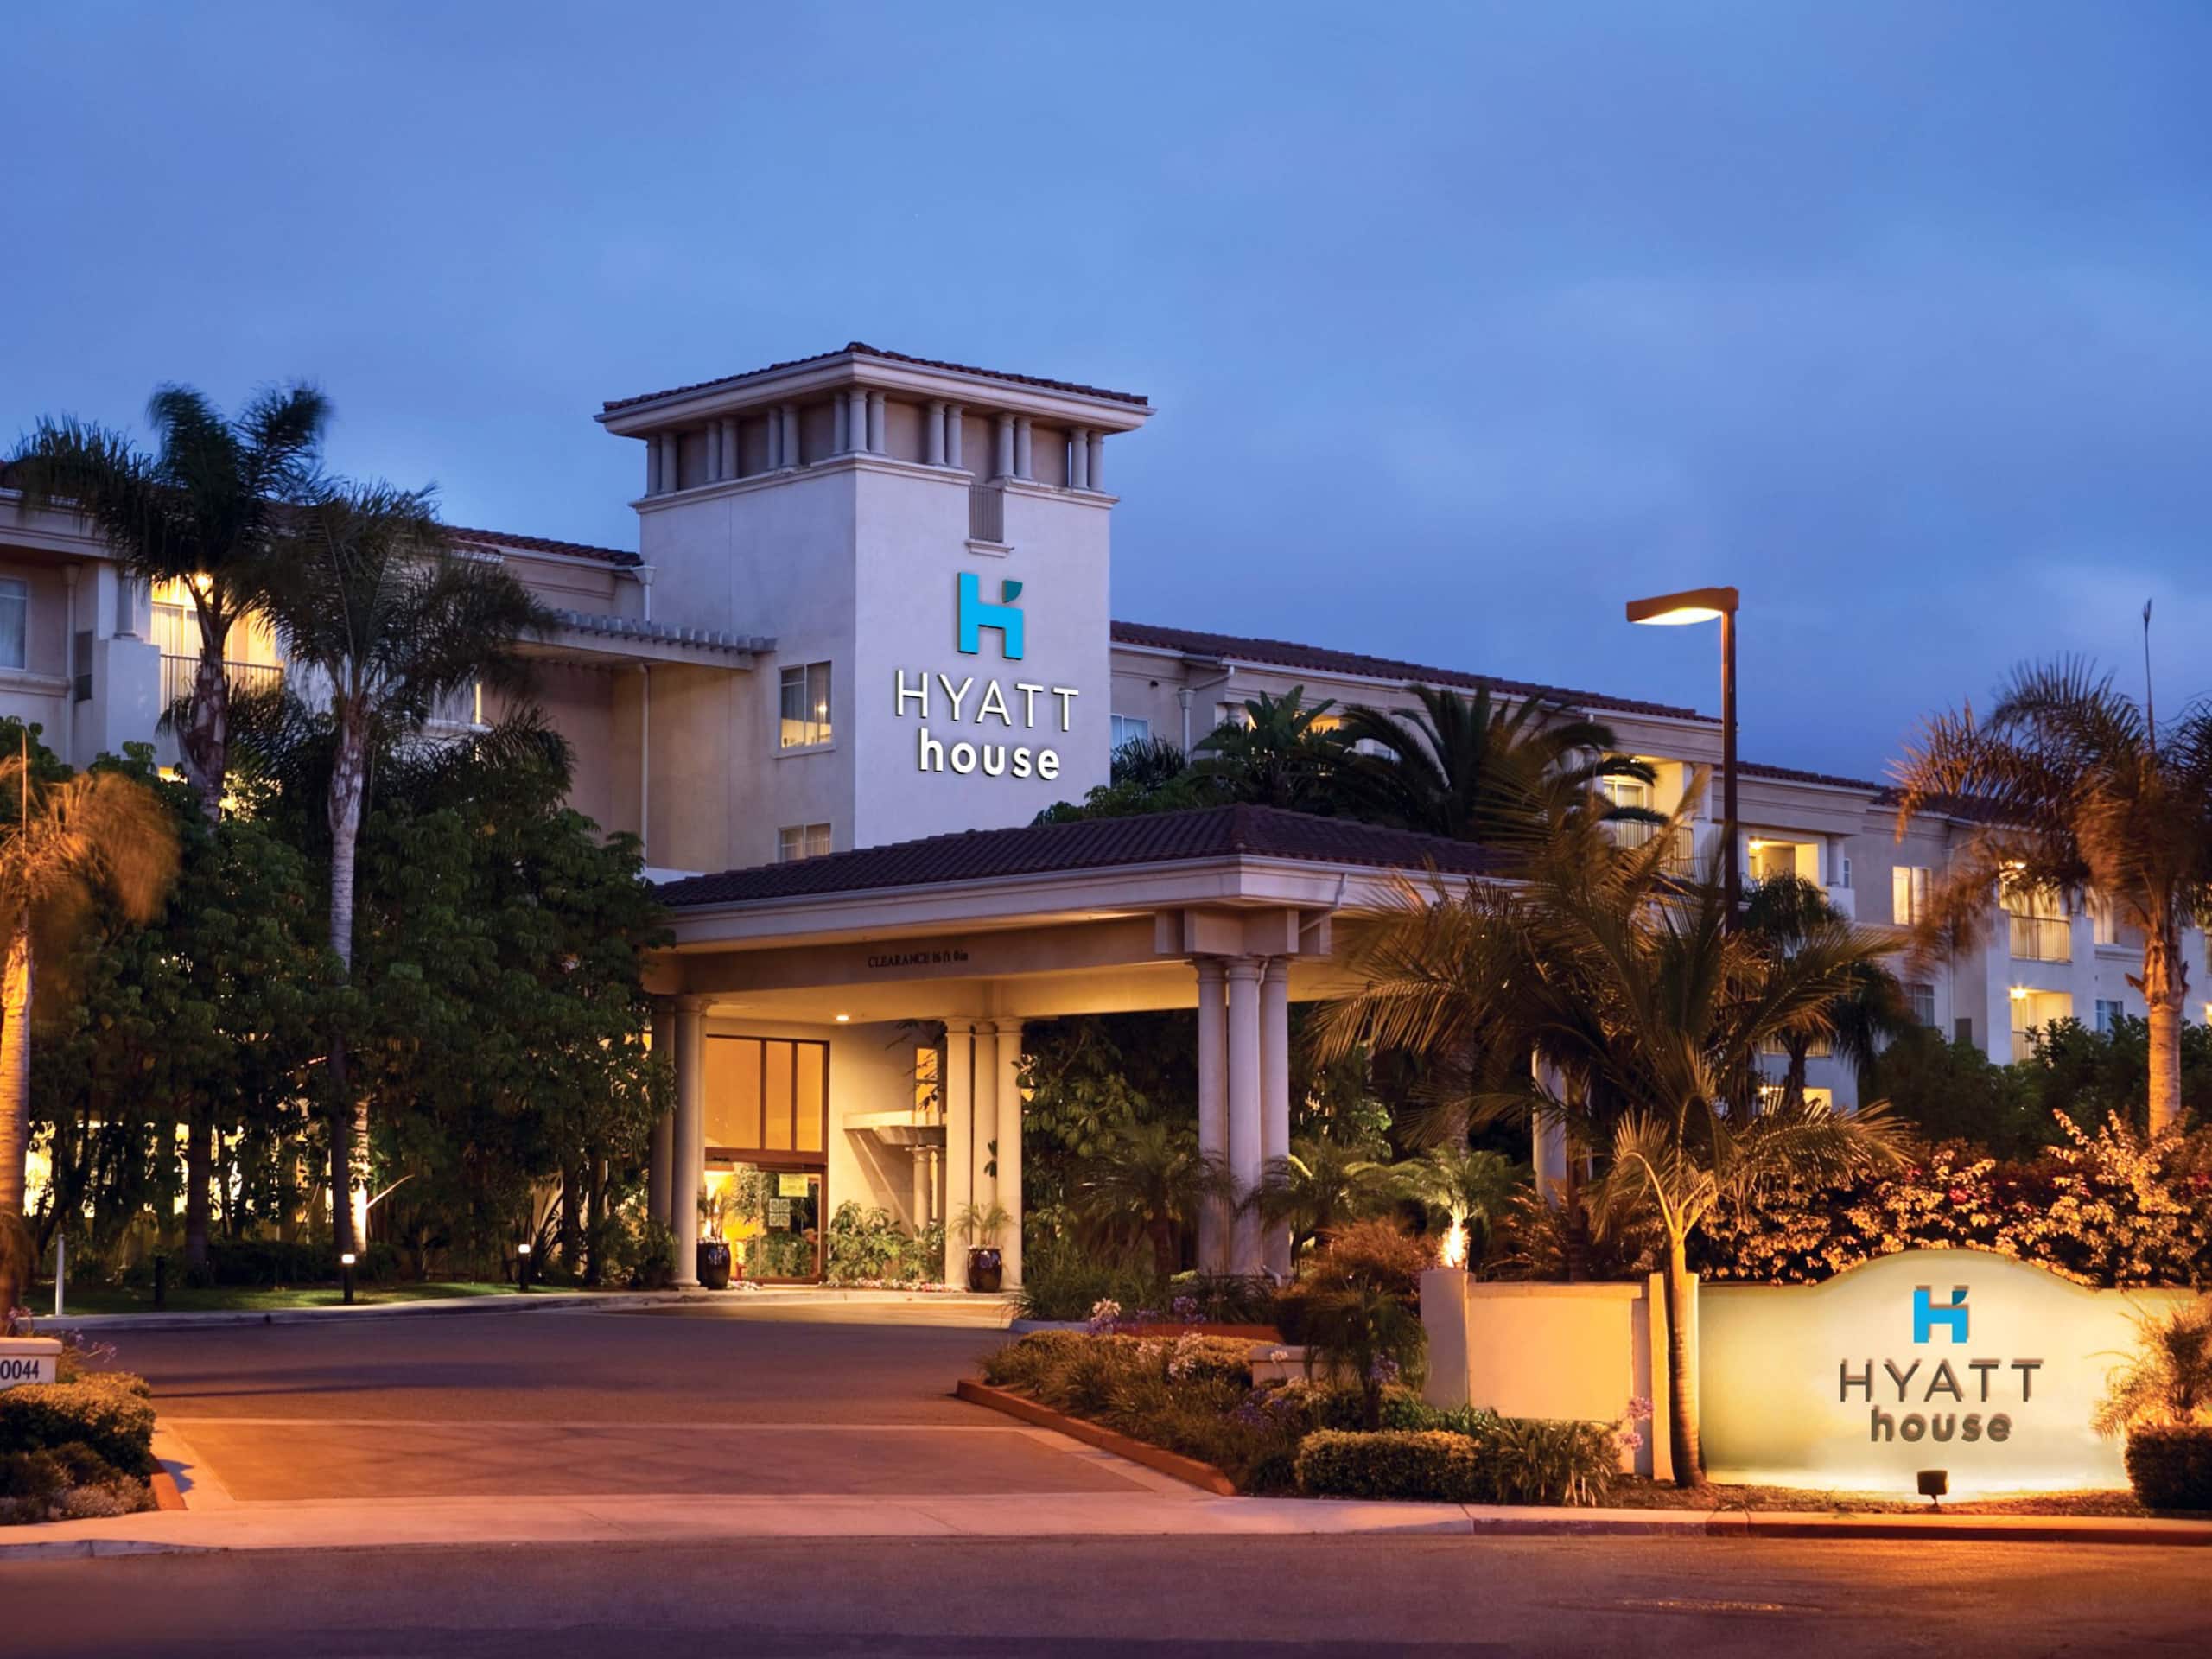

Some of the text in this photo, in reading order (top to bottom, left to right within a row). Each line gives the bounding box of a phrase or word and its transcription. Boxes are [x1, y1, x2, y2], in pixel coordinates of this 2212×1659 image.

[895, 670, 1078, 732] HYATT
[919, 728, 1059, 779] house
[0, 1359, 39, 1380] 0044
[1840, 1358, 2044, 1402] HYATT
[1871, 1405, 2012, 1442] house
